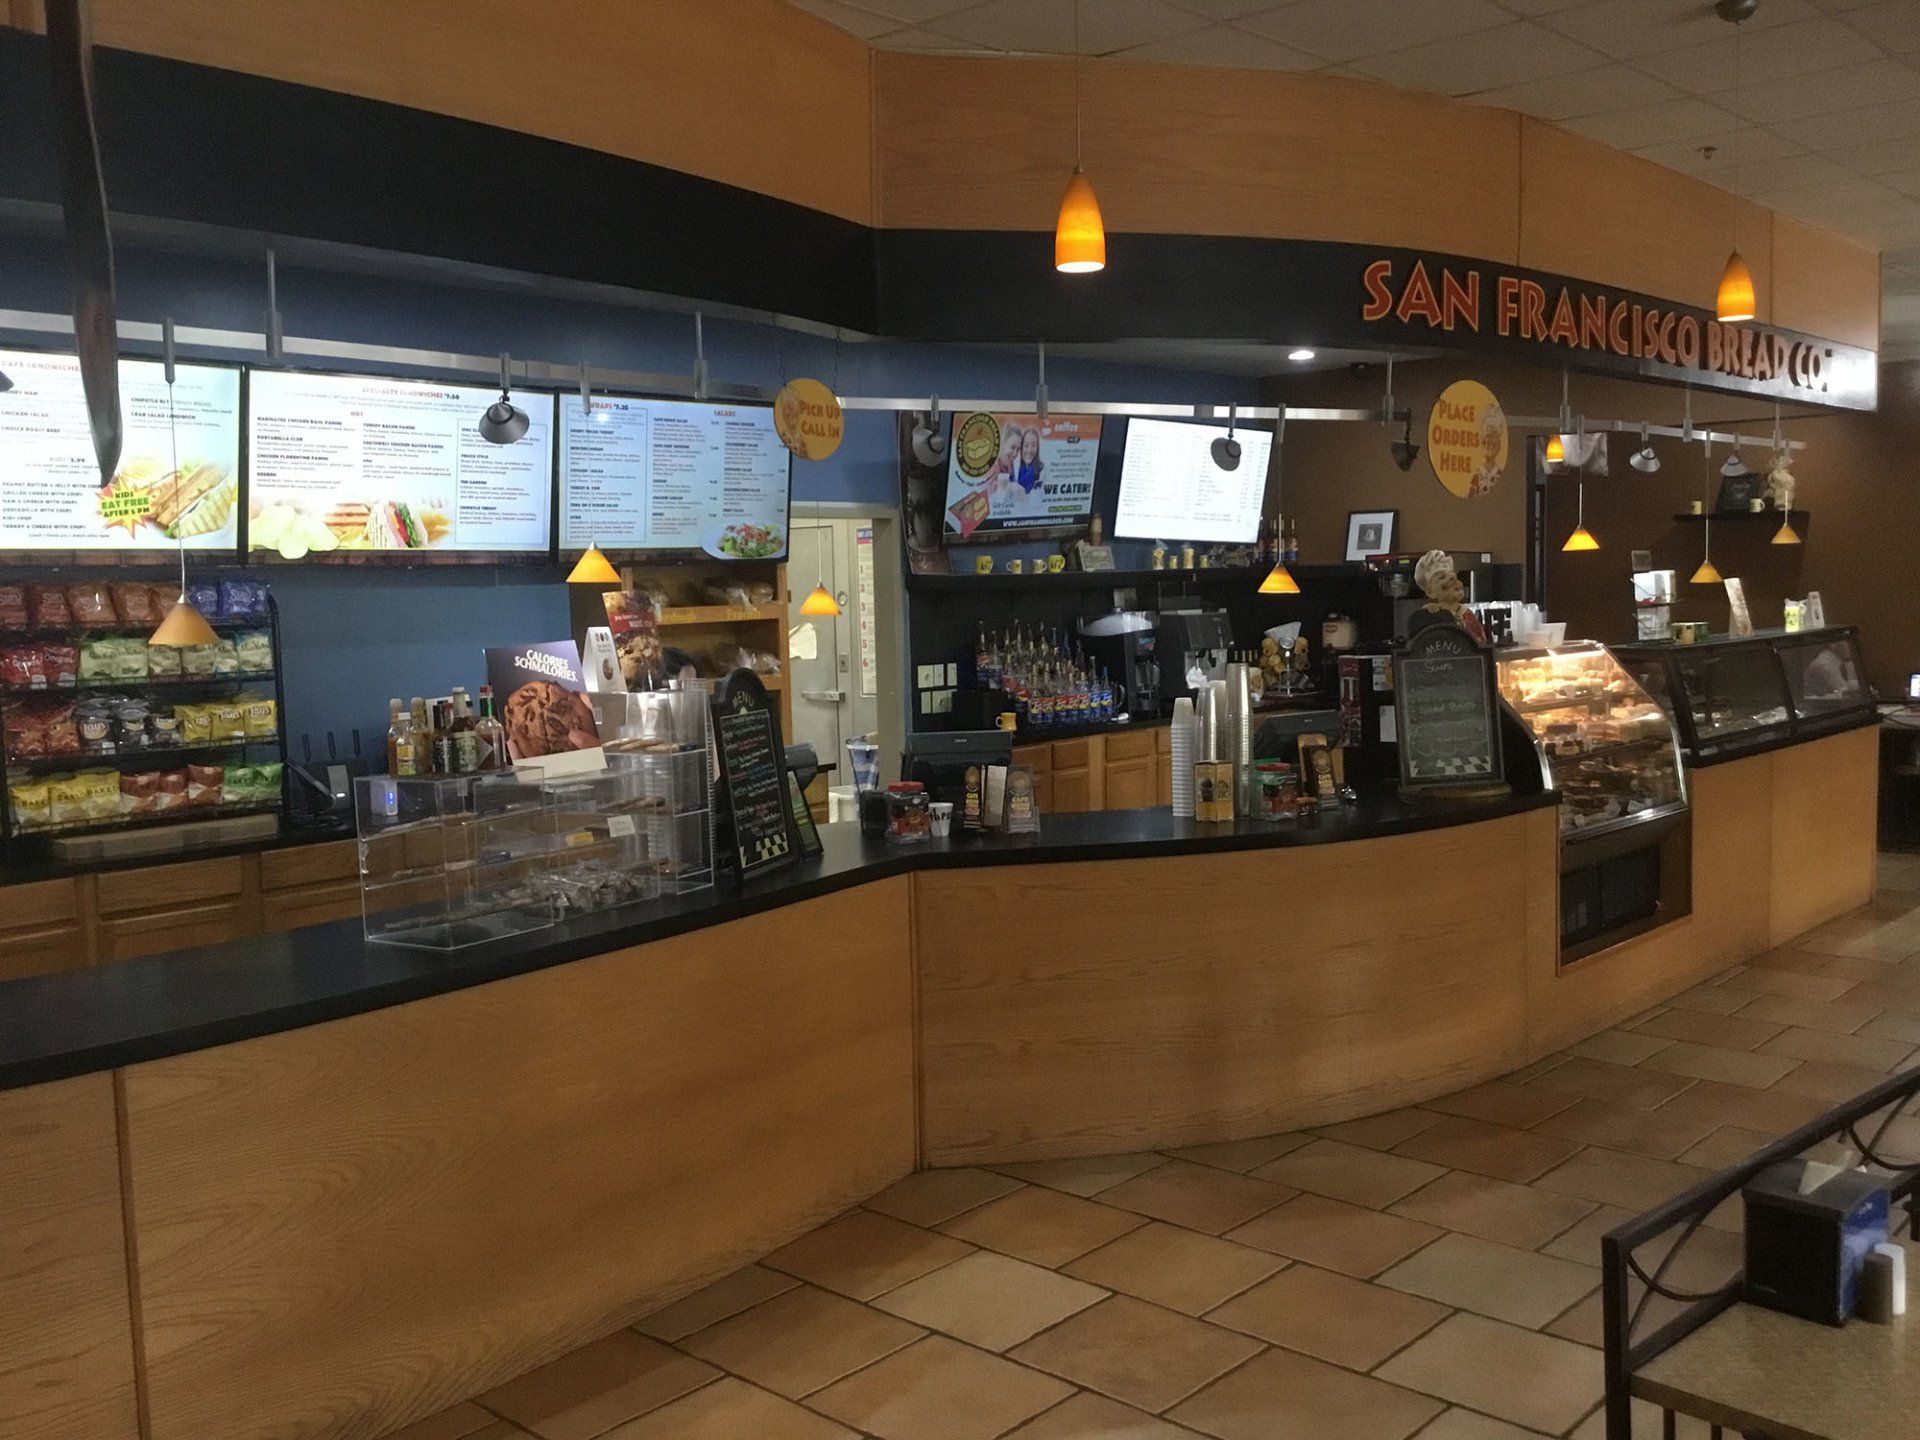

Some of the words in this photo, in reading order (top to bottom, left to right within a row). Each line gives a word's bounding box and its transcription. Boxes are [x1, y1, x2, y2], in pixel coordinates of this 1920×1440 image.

[1363, 260, 1480, 332] SAN
[1498, 276, 1699, 368] FRANCISCO
[1707, 320, 1789, 380] BREAD
[28, 362, 81, 372] SANDWICHE
[799, 400, 824, 417] PICK
[826, 405, 841, 419] UP
[1439, 399, 1475, 423] PLACE
[801, 420, 826, 437] CALL
[828, 424, 840, 438] IN
[1432, 425, 1480, 448] ORDERS
[1440, 450, 1472, 473] HERE
[115, 491, 134, 499] KIDS
[1044, 484, 1059, 495] WE
[102, 501, 121, 510] EAT
[123, 498, 150, 507] FREE
[103, 510, 129, 518] AFTER
[1425, 640, 1462, 656] MENU
[526, 649, 569, 669] CALORIES
[513, 656, 578, 682] SCHMALORIES.
